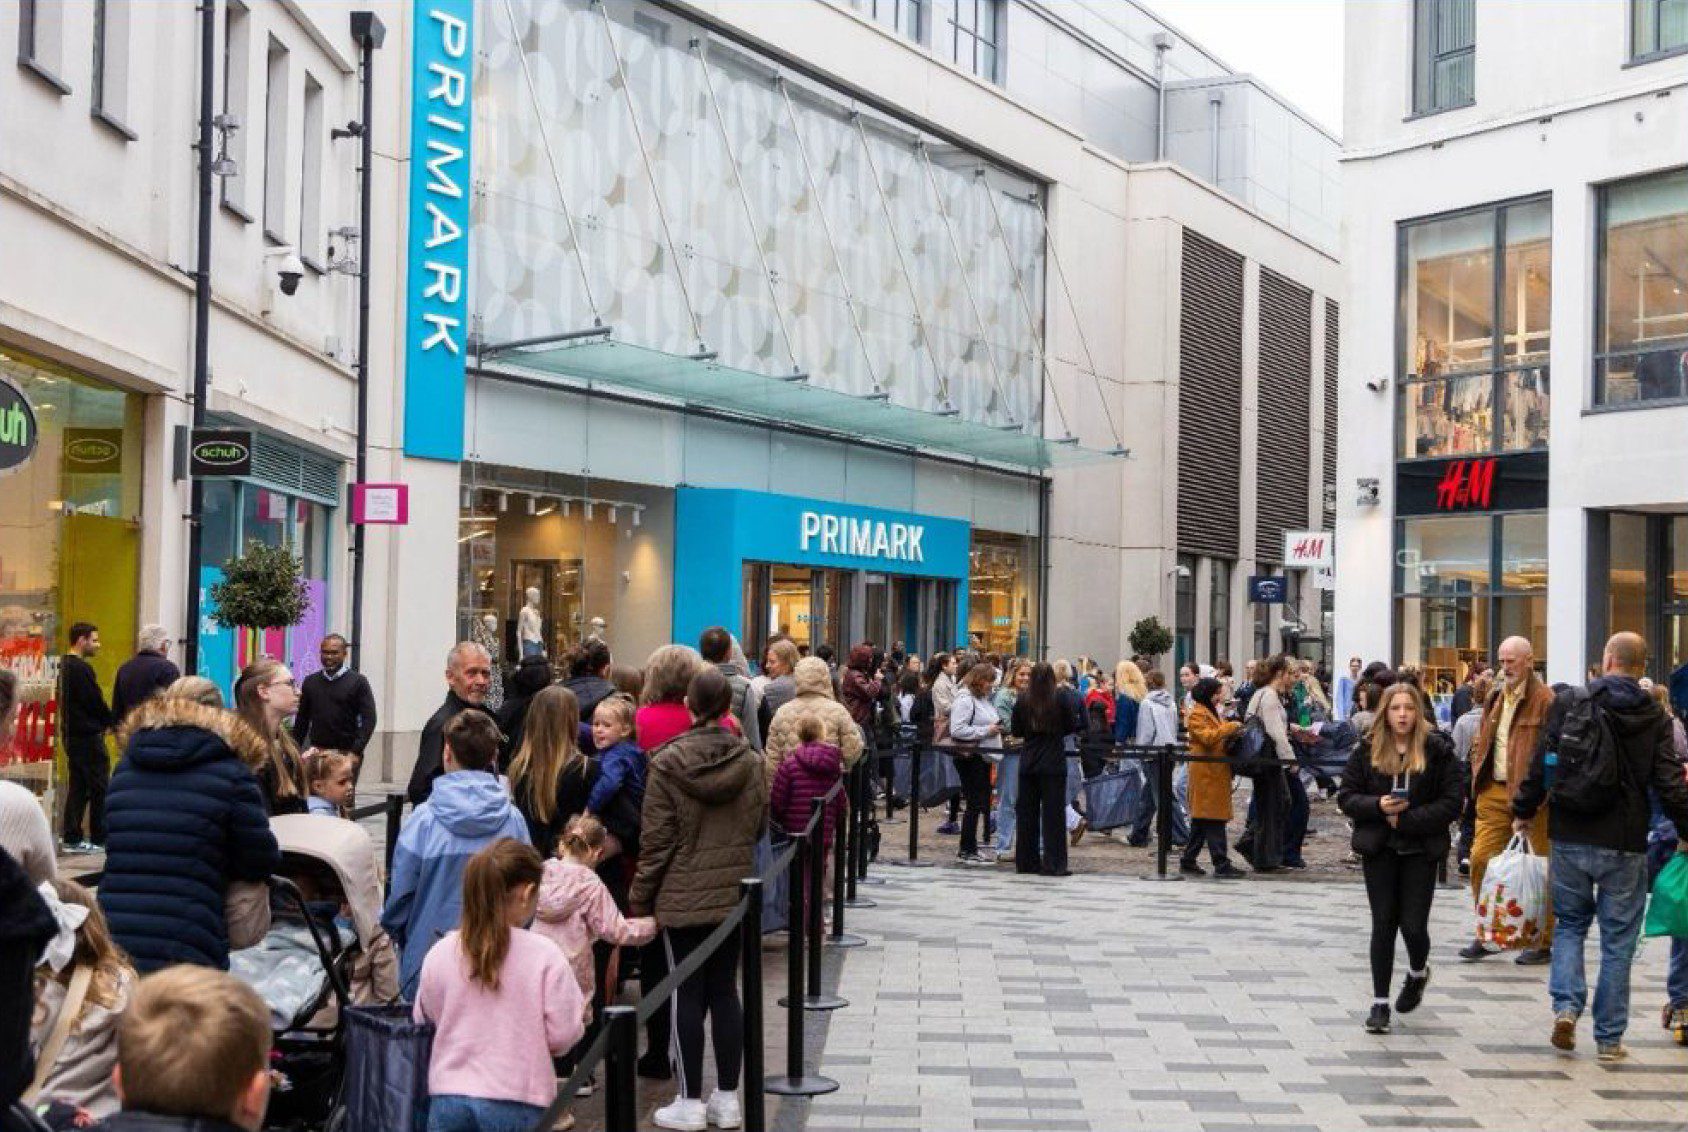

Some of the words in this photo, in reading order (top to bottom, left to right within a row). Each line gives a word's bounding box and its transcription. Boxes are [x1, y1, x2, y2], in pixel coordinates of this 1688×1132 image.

[421, 9, 468, 355] PRIMARK
[201, 447, 241, 458] schuh
[1437, 459, 1495, 511] H&M
[800, 512, 925, 563] PRIMARK
[1292, 538, 1324, 560] H&M
